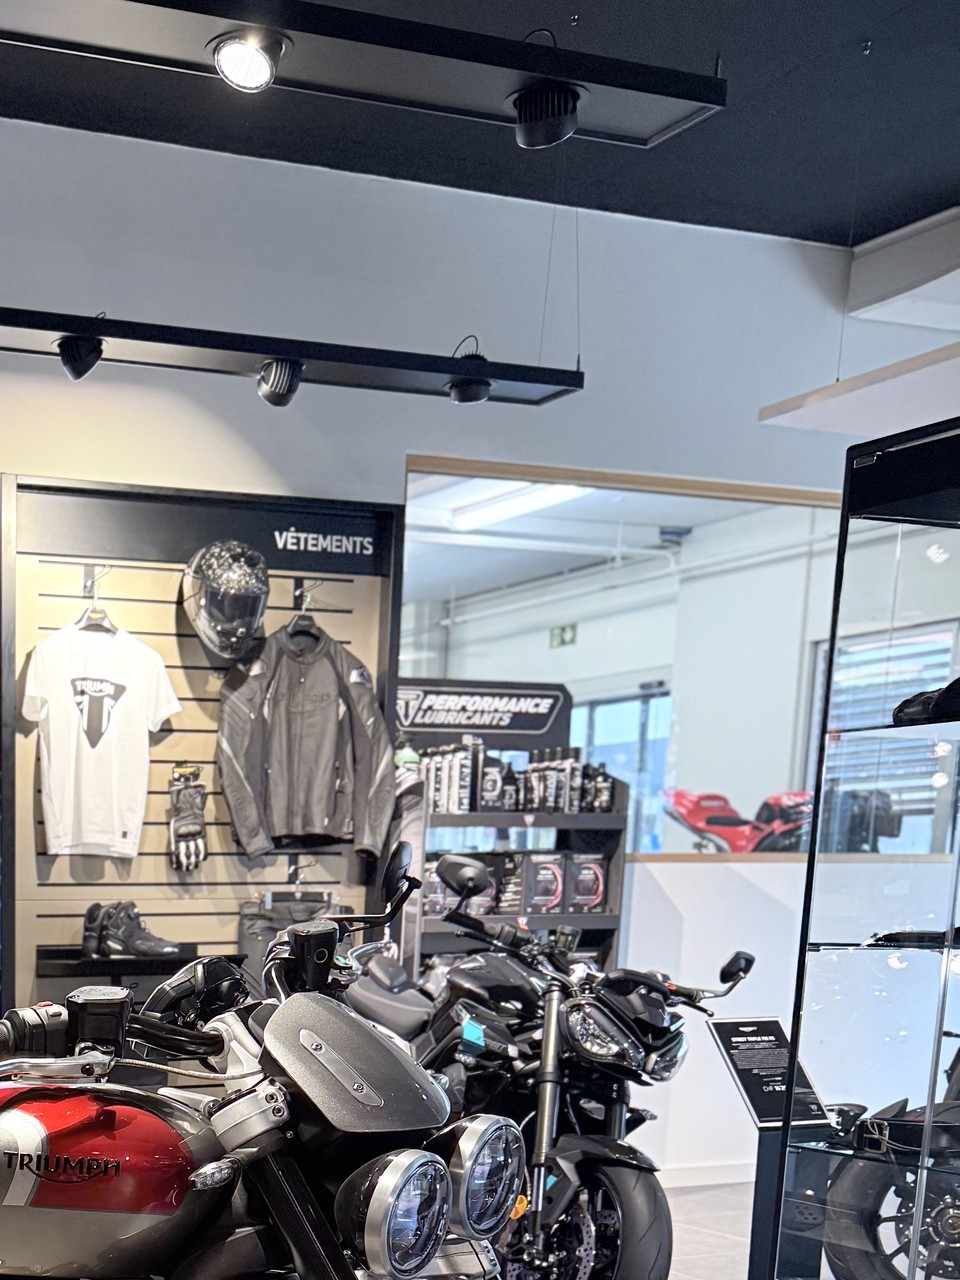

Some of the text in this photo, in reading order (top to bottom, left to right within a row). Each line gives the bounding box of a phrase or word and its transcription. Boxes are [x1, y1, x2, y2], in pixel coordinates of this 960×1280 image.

[273, 526, 374, 555] VÊTEMENTS
[421, 694, 554, 714] PERFORMANCE
[414, 710, 514, 727] LUBRICANTS
[3, 1150, 121, 1184] TRIUMPH
